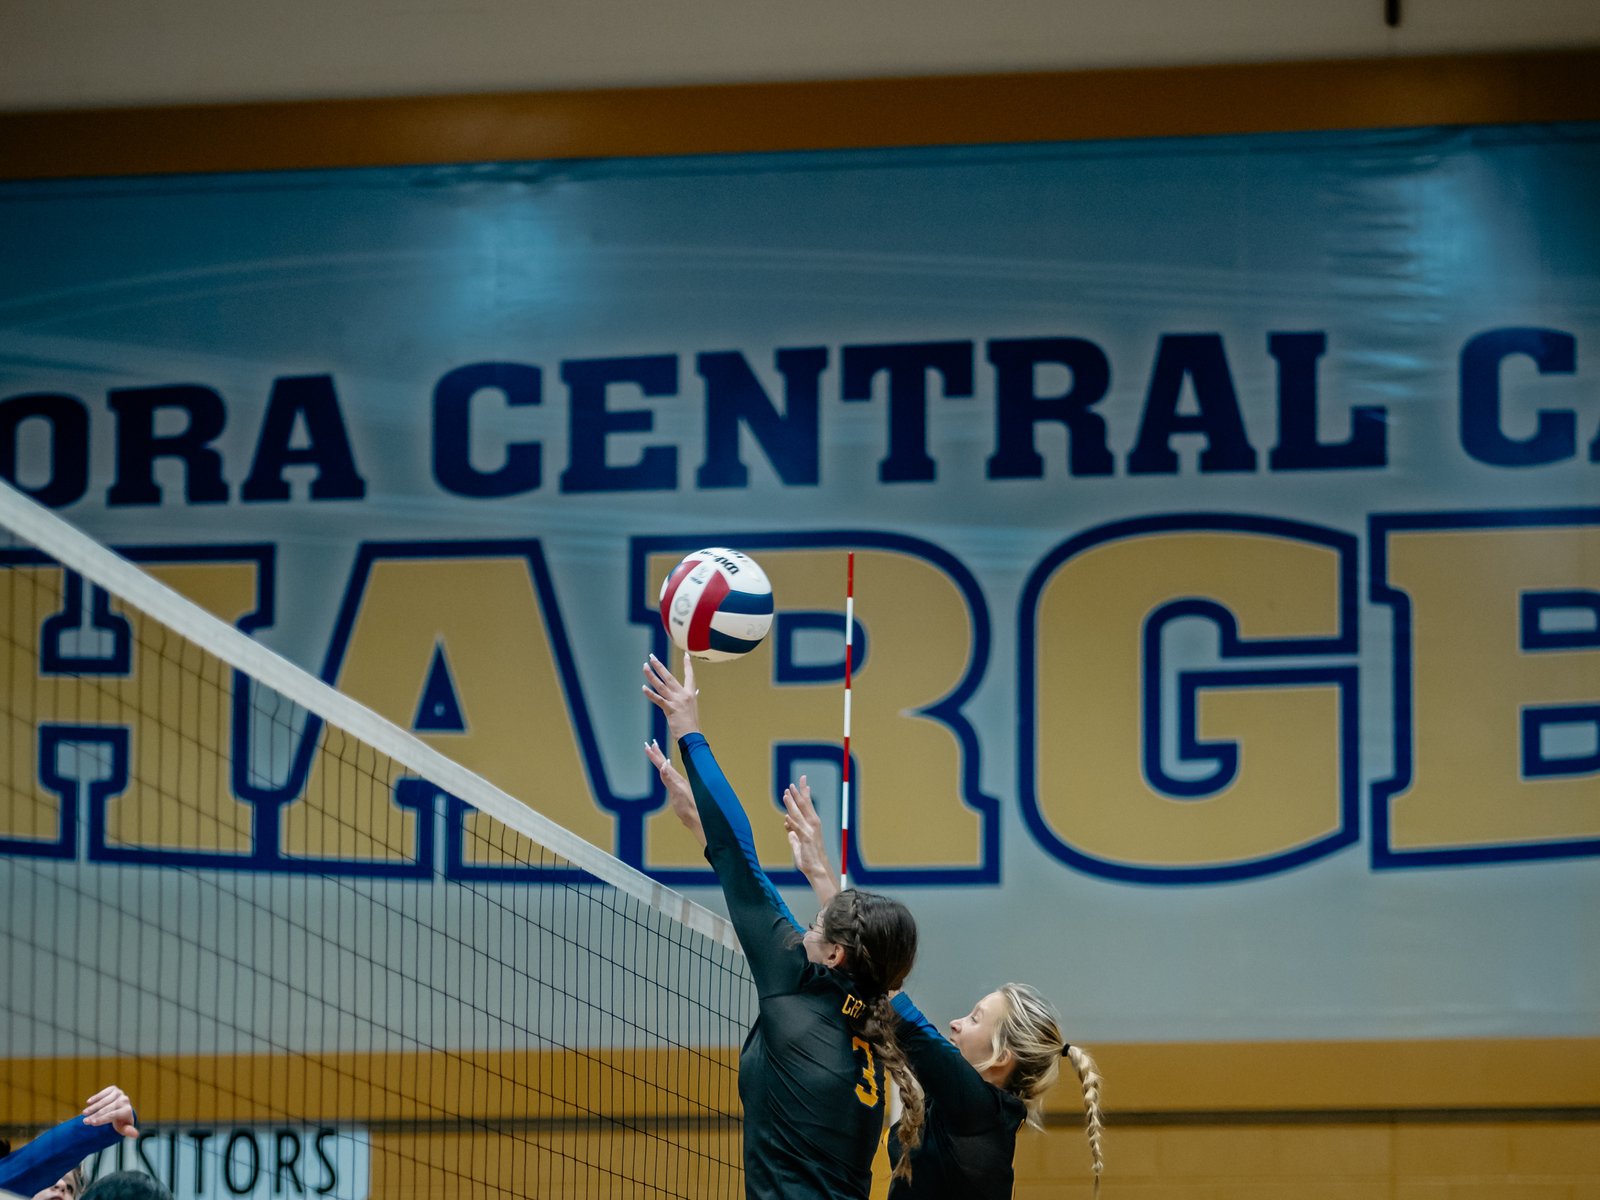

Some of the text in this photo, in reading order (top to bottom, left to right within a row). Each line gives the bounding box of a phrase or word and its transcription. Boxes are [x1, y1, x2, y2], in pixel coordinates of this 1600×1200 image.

[431, 330, 1390, 499] CENTRAL
[1458, 326, 1600, 469] C
[841, 993, 867, 1020] CA
[852, 1036, 879, 1108] 3
[92, 1127, 337, 1195] ISITORS
